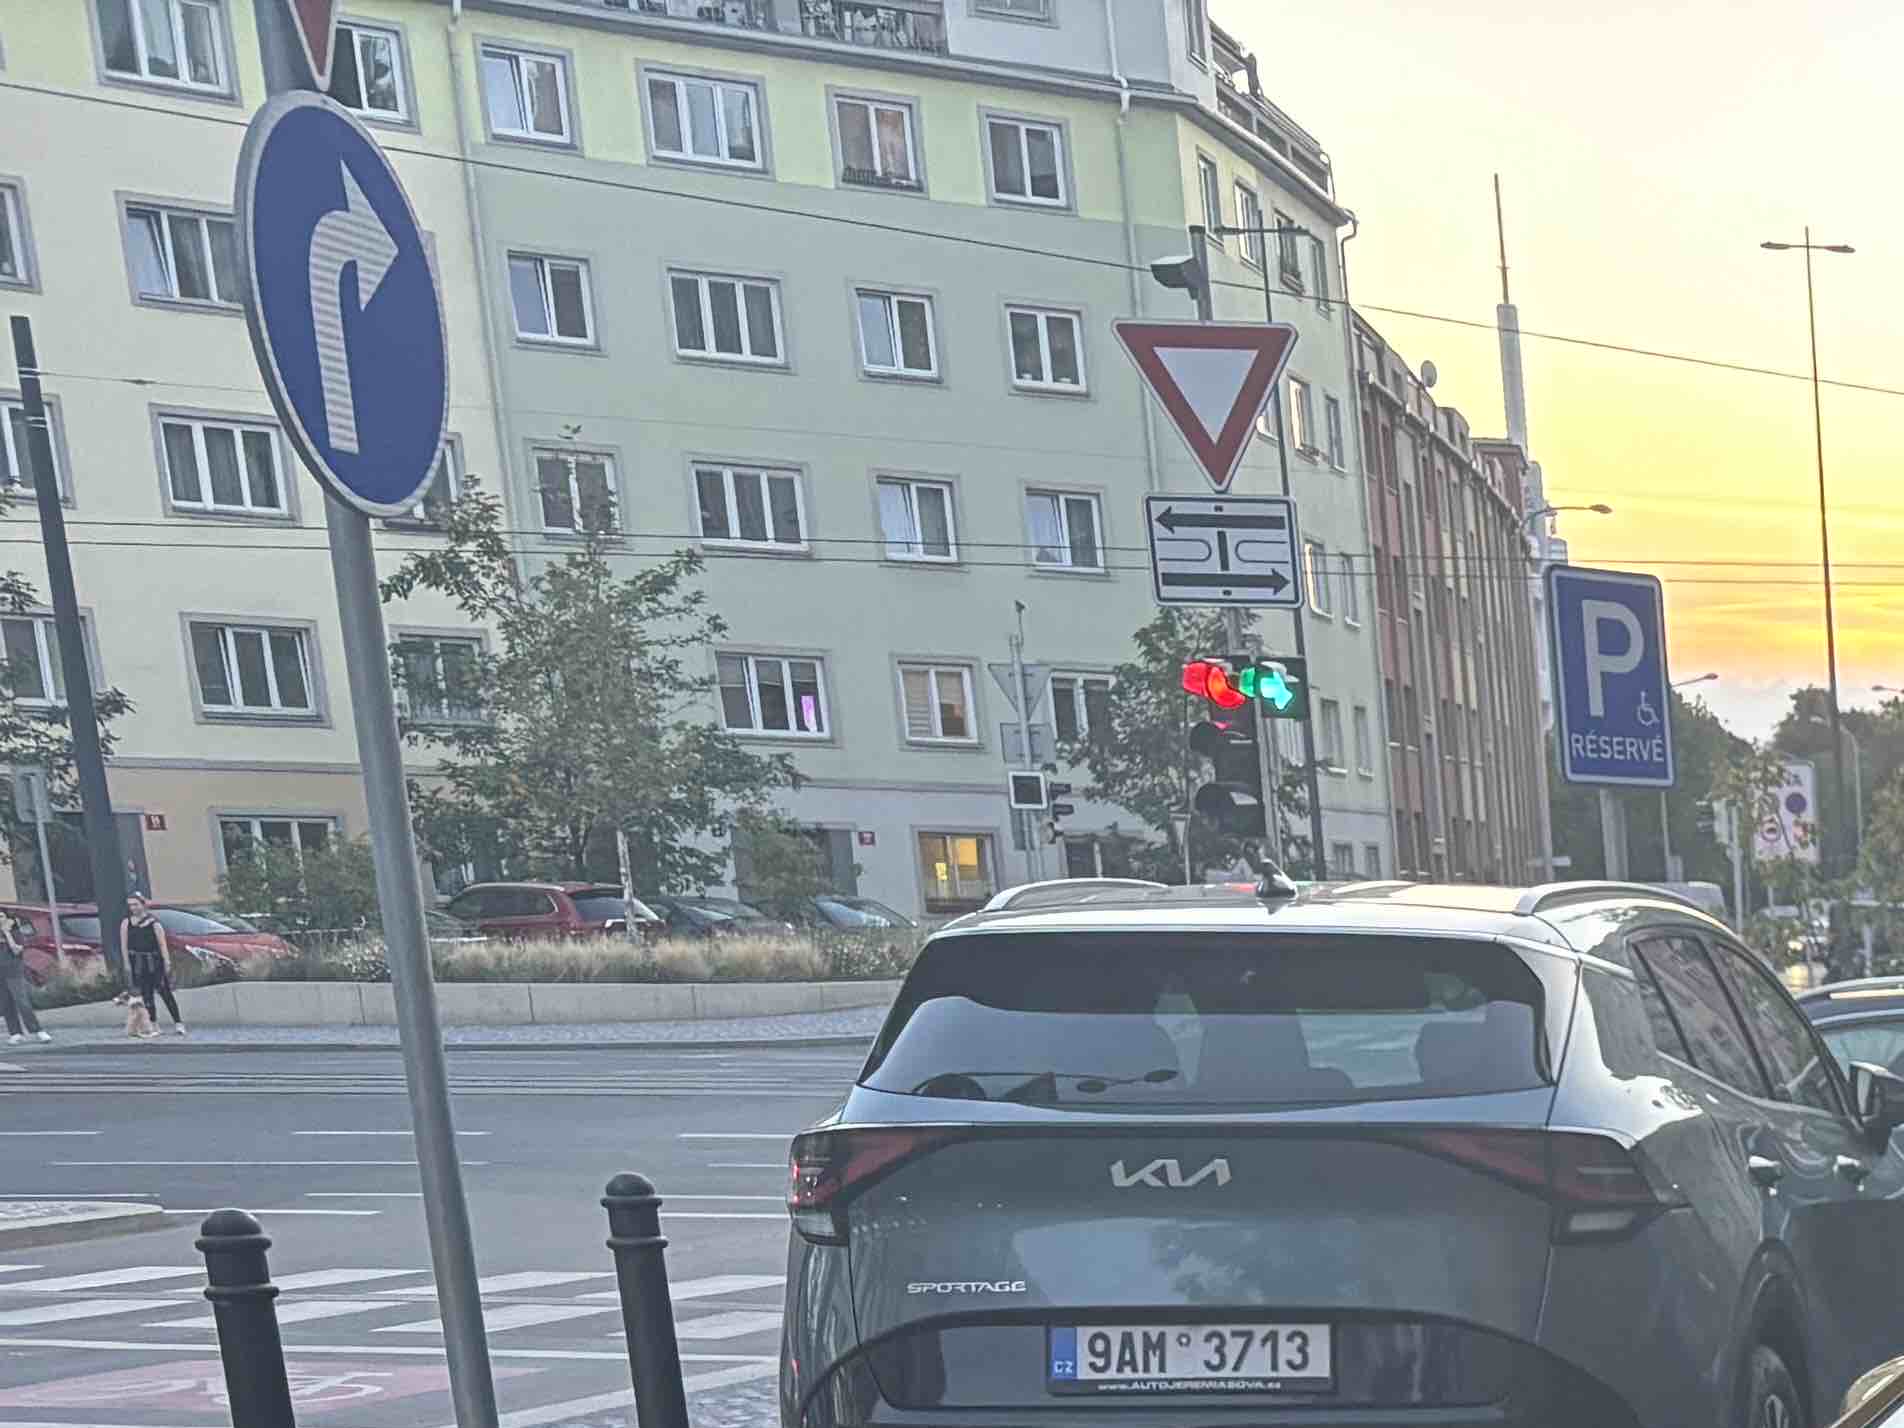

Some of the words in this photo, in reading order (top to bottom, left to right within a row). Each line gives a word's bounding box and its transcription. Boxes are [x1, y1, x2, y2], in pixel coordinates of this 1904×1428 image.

[1581, 599, 1644, 717] P
[1571, 730, 1665, 762] RÉSERVÉ
[1110, 1158, 1233, 1187] KIA
[907, 1280, 1026, 1294] SPORTAGE
[1054, 1361, 1074, 1374] CZ
[1086, 1330, 1167, 1374] 9AM
[1203, 1329, 1310, 1373] 3713
